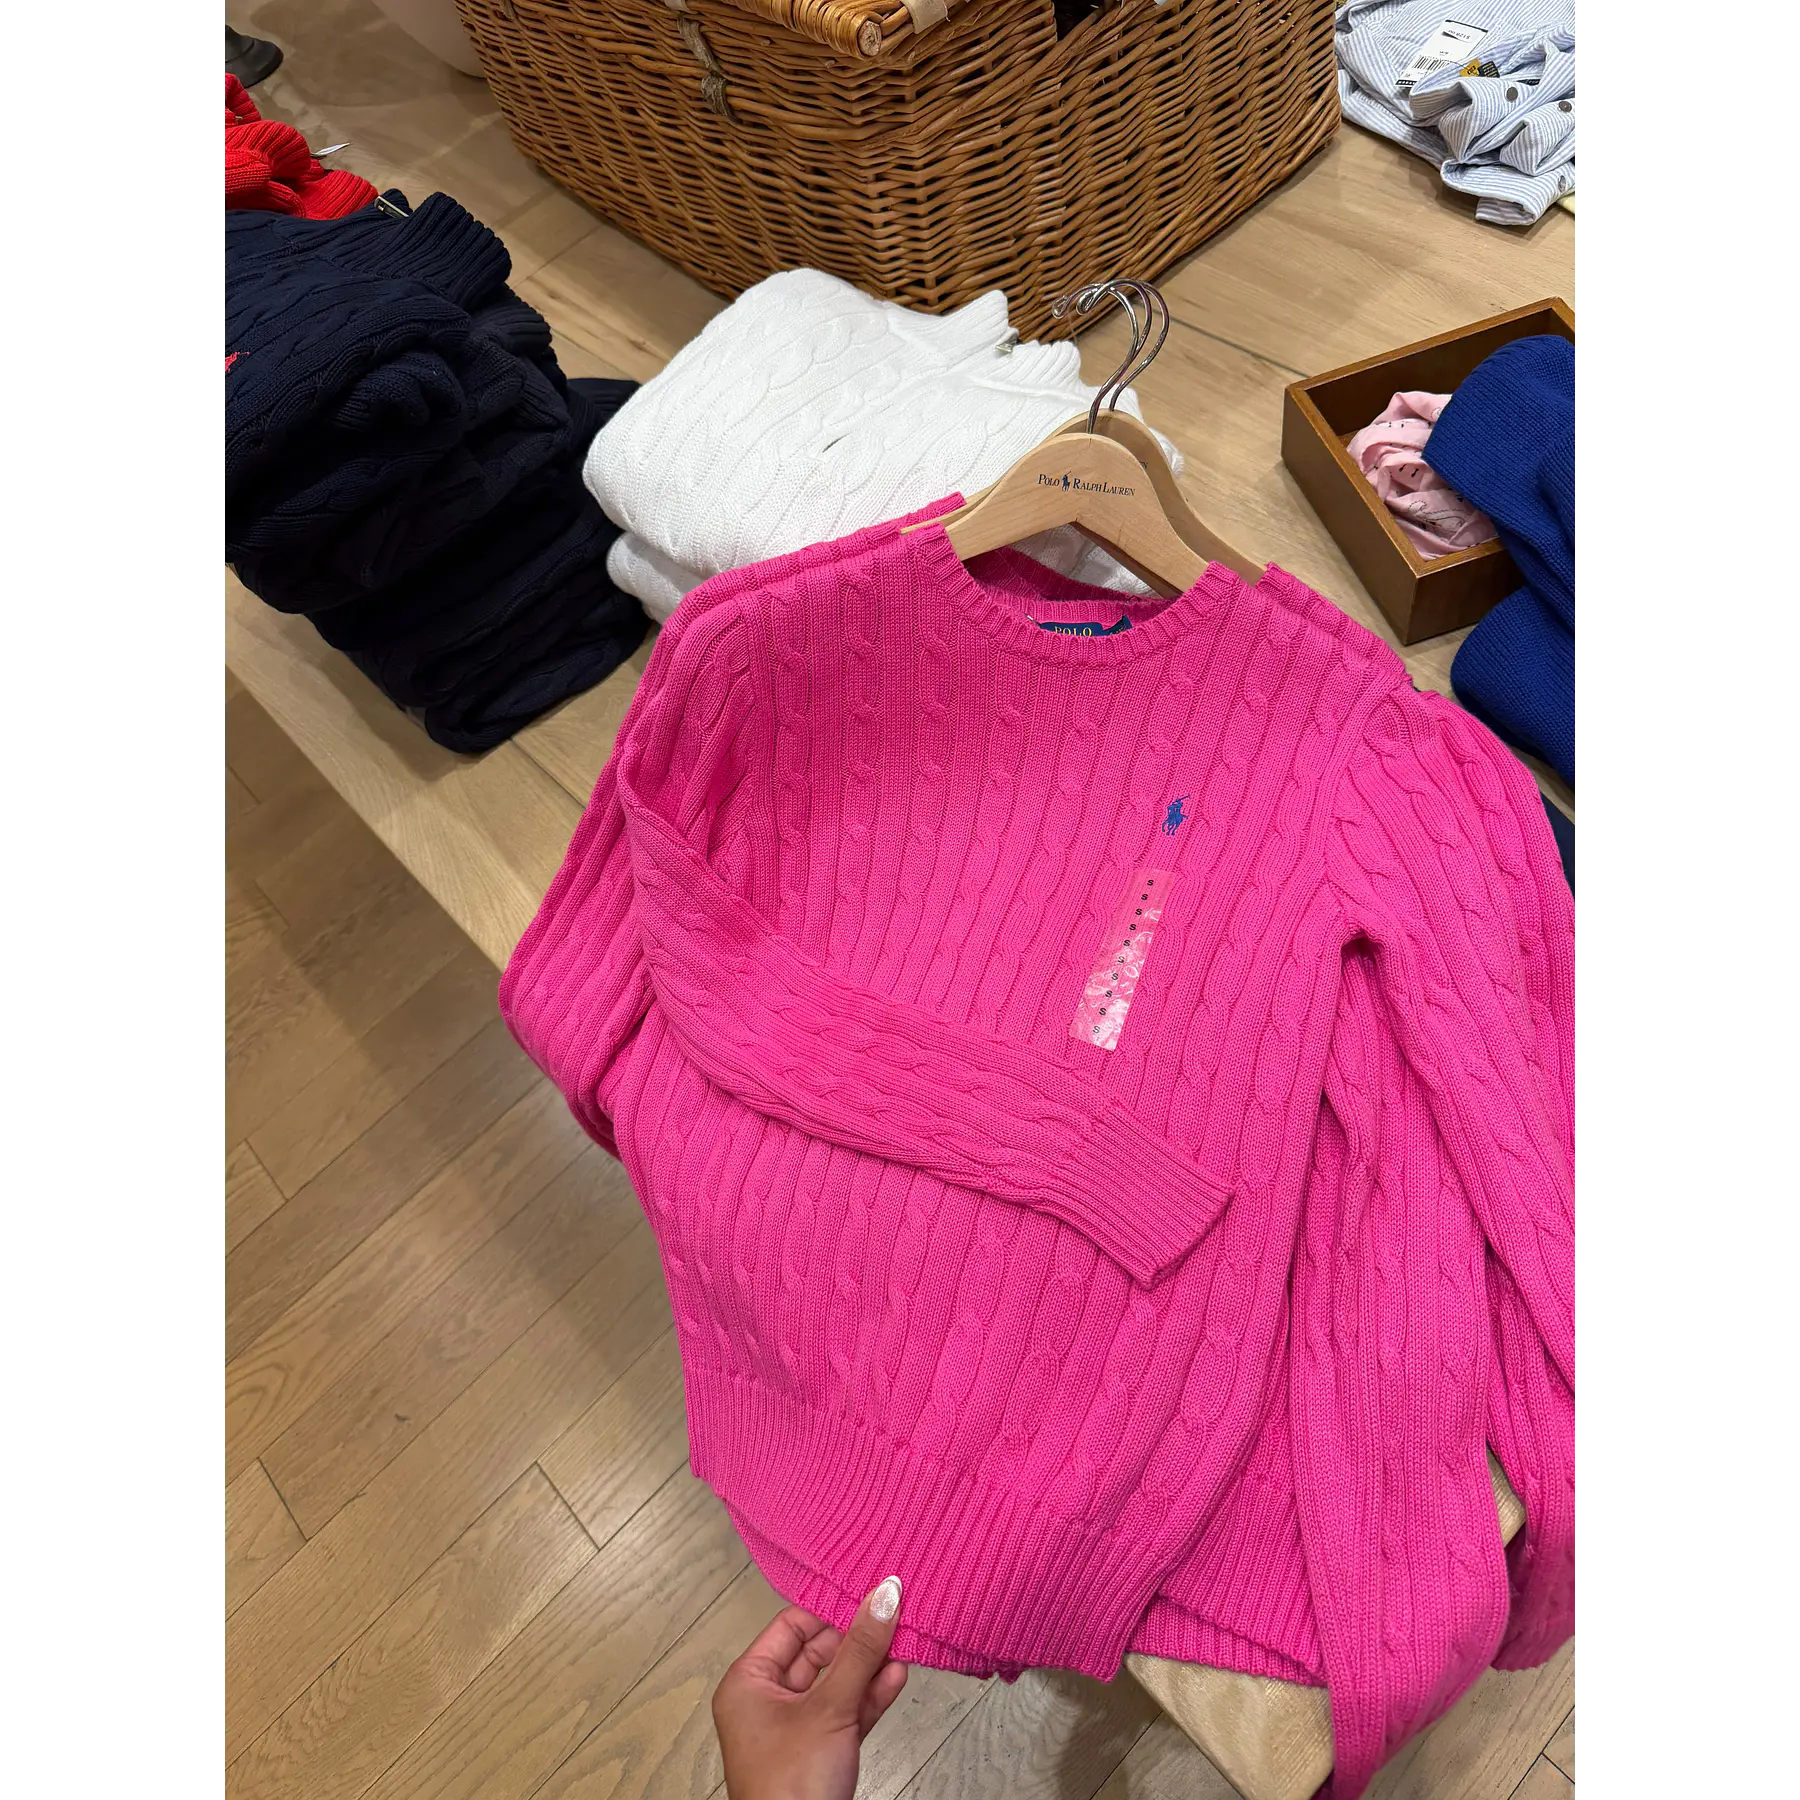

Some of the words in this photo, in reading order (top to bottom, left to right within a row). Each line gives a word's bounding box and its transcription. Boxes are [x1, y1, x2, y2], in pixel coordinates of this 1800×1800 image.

[1037, 473, 1060, 487] POLO
[1072, 478, 1102, 492] RALPH
[1102, 482, 1136, 496] LAUREN
[1054, 626, 1092, 637] POLO
[1129, 923, 1137, 931] S
[1123, 939, 1131, 947] S
[1117, 956, 1125, 964] S
[1111, 972, 1119, 980] S
[1105, 990, 1113, 998] S
[1099, 1007, 1107, 1016] S
[1092, 1025, 1100, 1034] S
